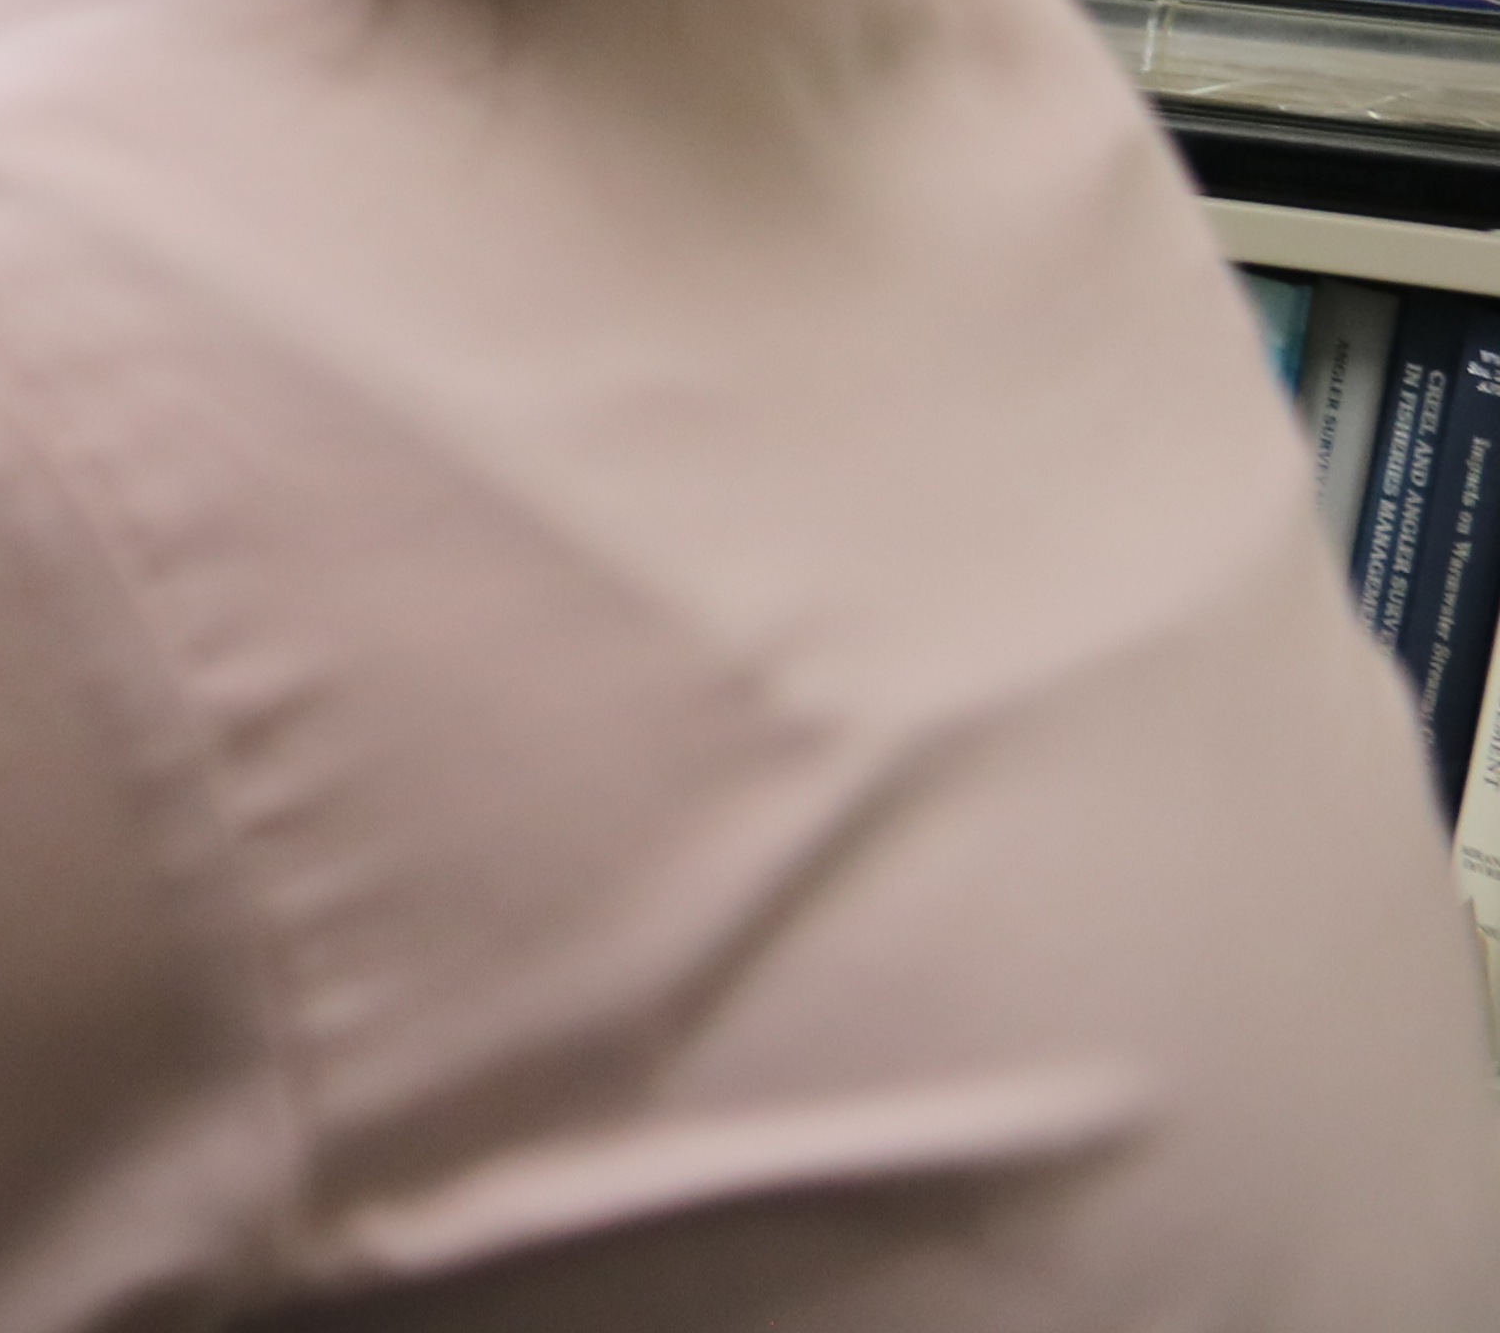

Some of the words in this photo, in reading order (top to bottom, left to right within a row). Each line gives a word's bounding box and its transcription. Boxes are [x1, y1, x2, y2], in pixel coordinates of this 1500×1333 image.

[1325, 340, 1351, 410] ANGLER
[1403, 362, 1424, 386] IN
[1418, 369, 1448, 436] CREEL
[1383, 388, 1417, 496] FISHERIES
[1410, 439, 1436, 487] AND
[1460, 437, 1491, 507] Impacts
[1393, 490, 1426, 573] ANGLER
[1456, 511, 1474, 535] on
[1435, 541, 1473, 642] Warmwater
